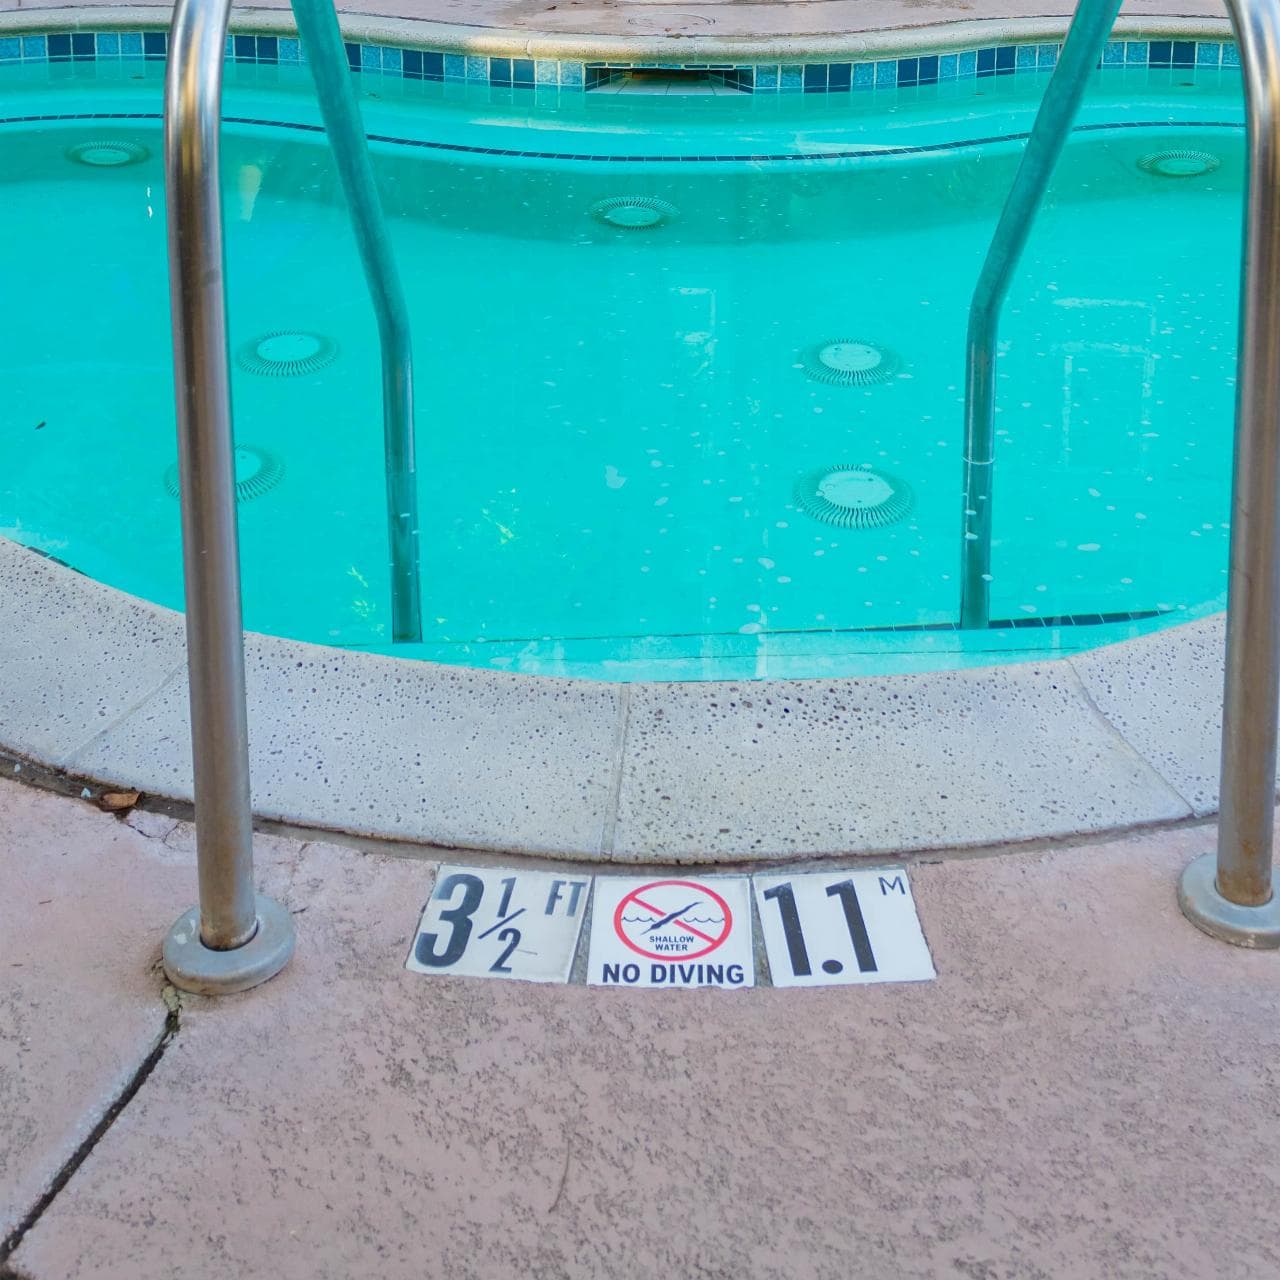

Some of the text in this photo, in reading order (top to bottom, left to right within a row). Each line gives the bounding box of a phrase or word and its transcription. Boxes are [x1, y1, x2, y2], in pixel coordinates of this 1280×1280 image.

[544, 880, 588, 918] FT
[763, 875, 906, 977] 1.1 M
[649, 935, 694, 943] SHALLOW
[655, 943, 688, 951] WATER
[602, 963, 745, 984] NO DIVING
